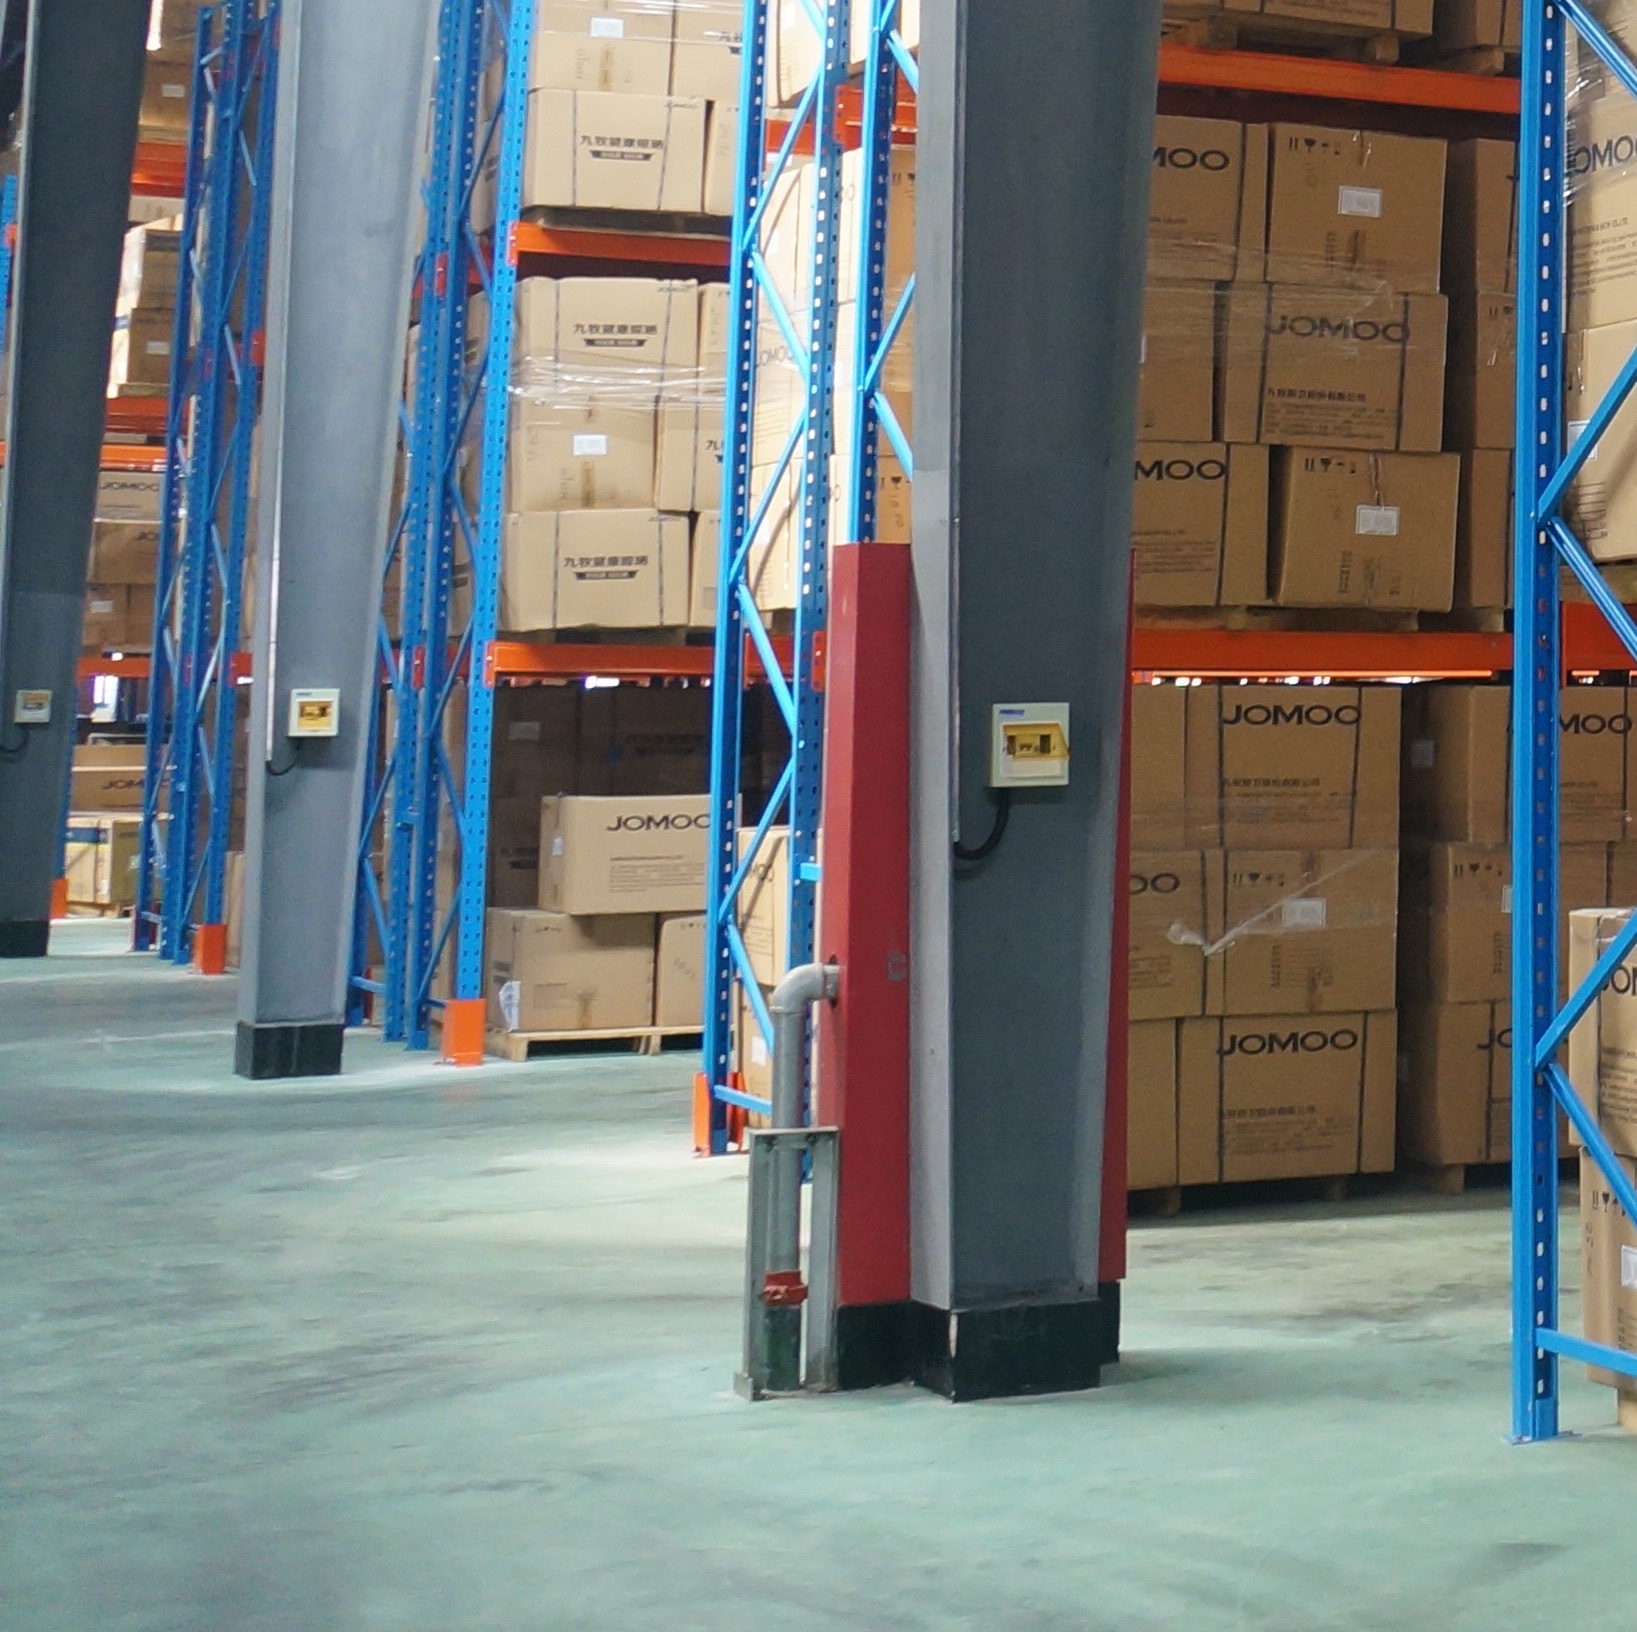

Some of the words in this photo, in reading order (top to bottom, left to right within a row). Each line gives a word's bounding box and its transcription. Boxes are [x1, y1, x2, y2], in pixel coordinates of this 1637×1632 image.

[1151, 147, 1229, 171] MOO
[1265, 314, 1409, 344] JOMOO
[1135, 459, 1226, 481] MOO
[1222, 704, 1360, 726] JOMOO
[1559, 713, 1633, 736] MOO
[1217, 1029, 1358, 1057] JOMOO
